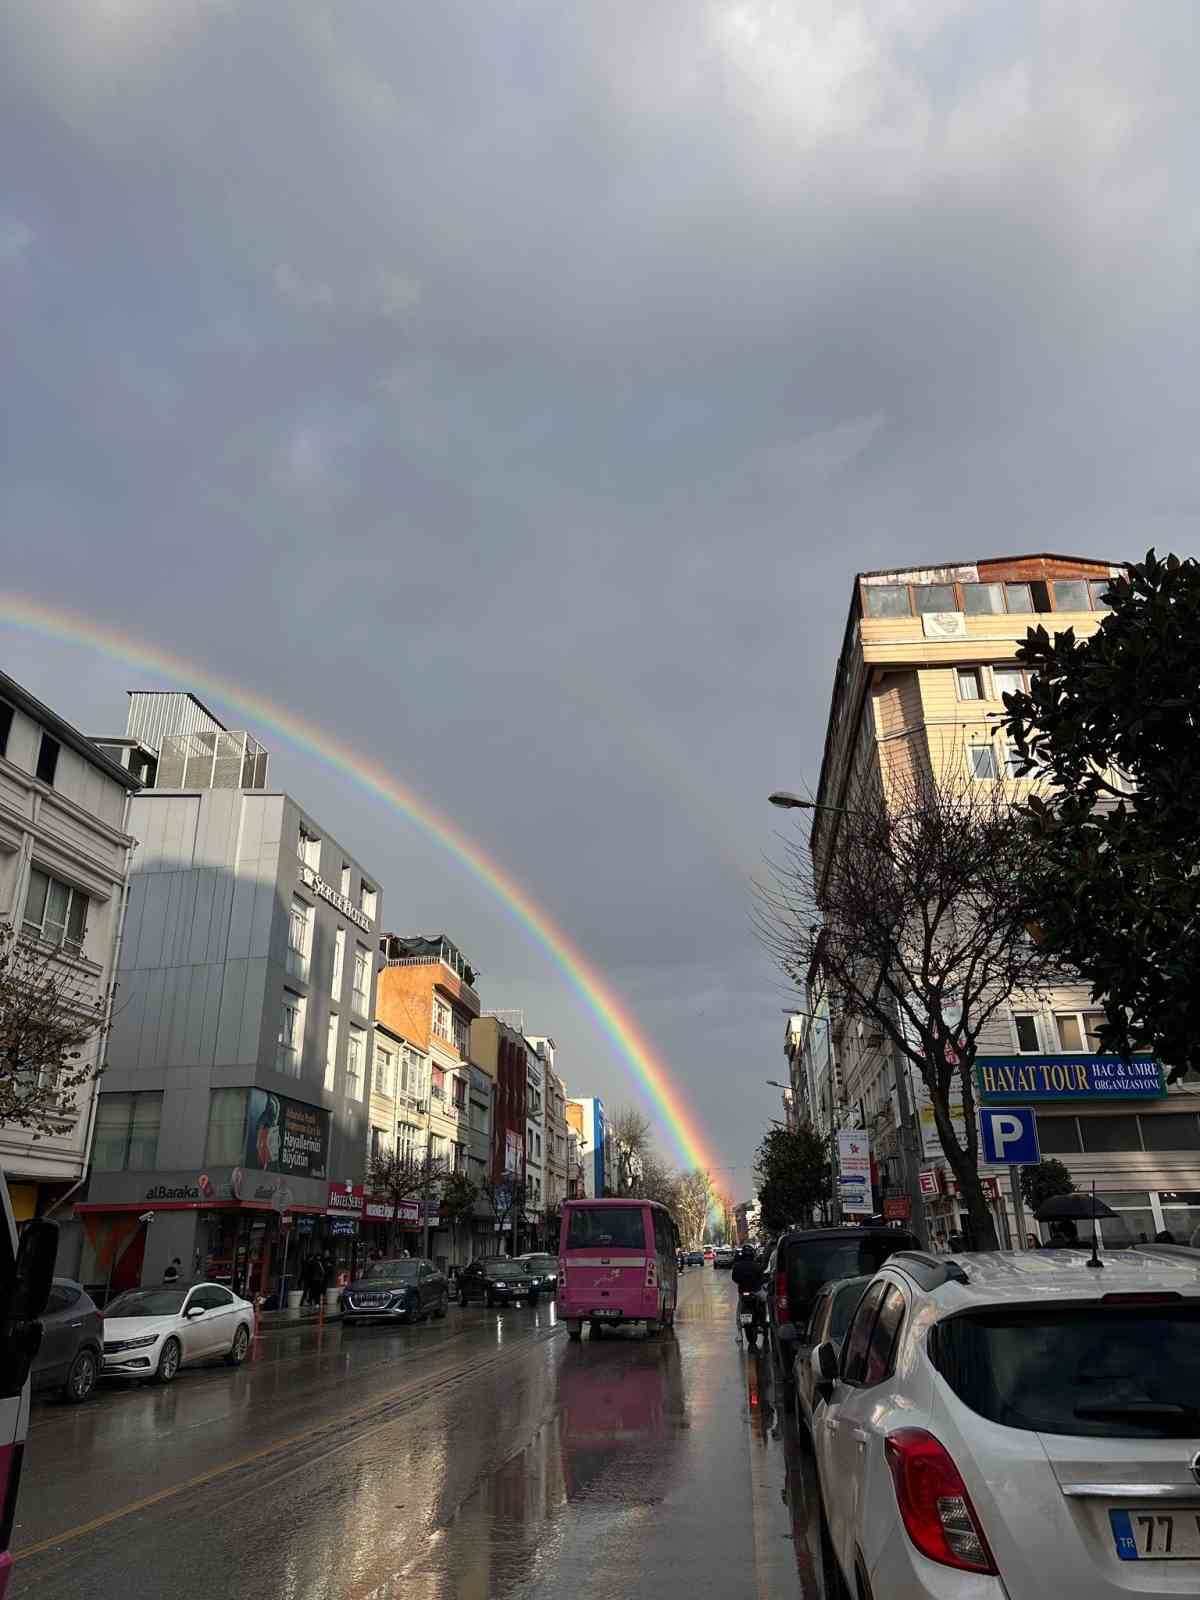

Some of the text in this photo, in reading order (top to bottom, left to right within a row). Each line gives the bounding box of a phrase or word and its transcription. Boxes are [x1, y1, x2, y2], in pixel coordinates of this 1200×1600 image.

[343, 899, 370, 932] HOTEL
[982, 1064, 1090, 1091] HAYAT TOUR
[1091, 1063, 1159, 1076] HAC & UMRE
[991, 1113, 1024, 1158] P
[146, 1185, 199, 1200] alBaraka
[920, 1177, 934, 1192] E
[1120, 1537, 1135, 1548] TR
[1137, 1516, 1174, 1553] 77
